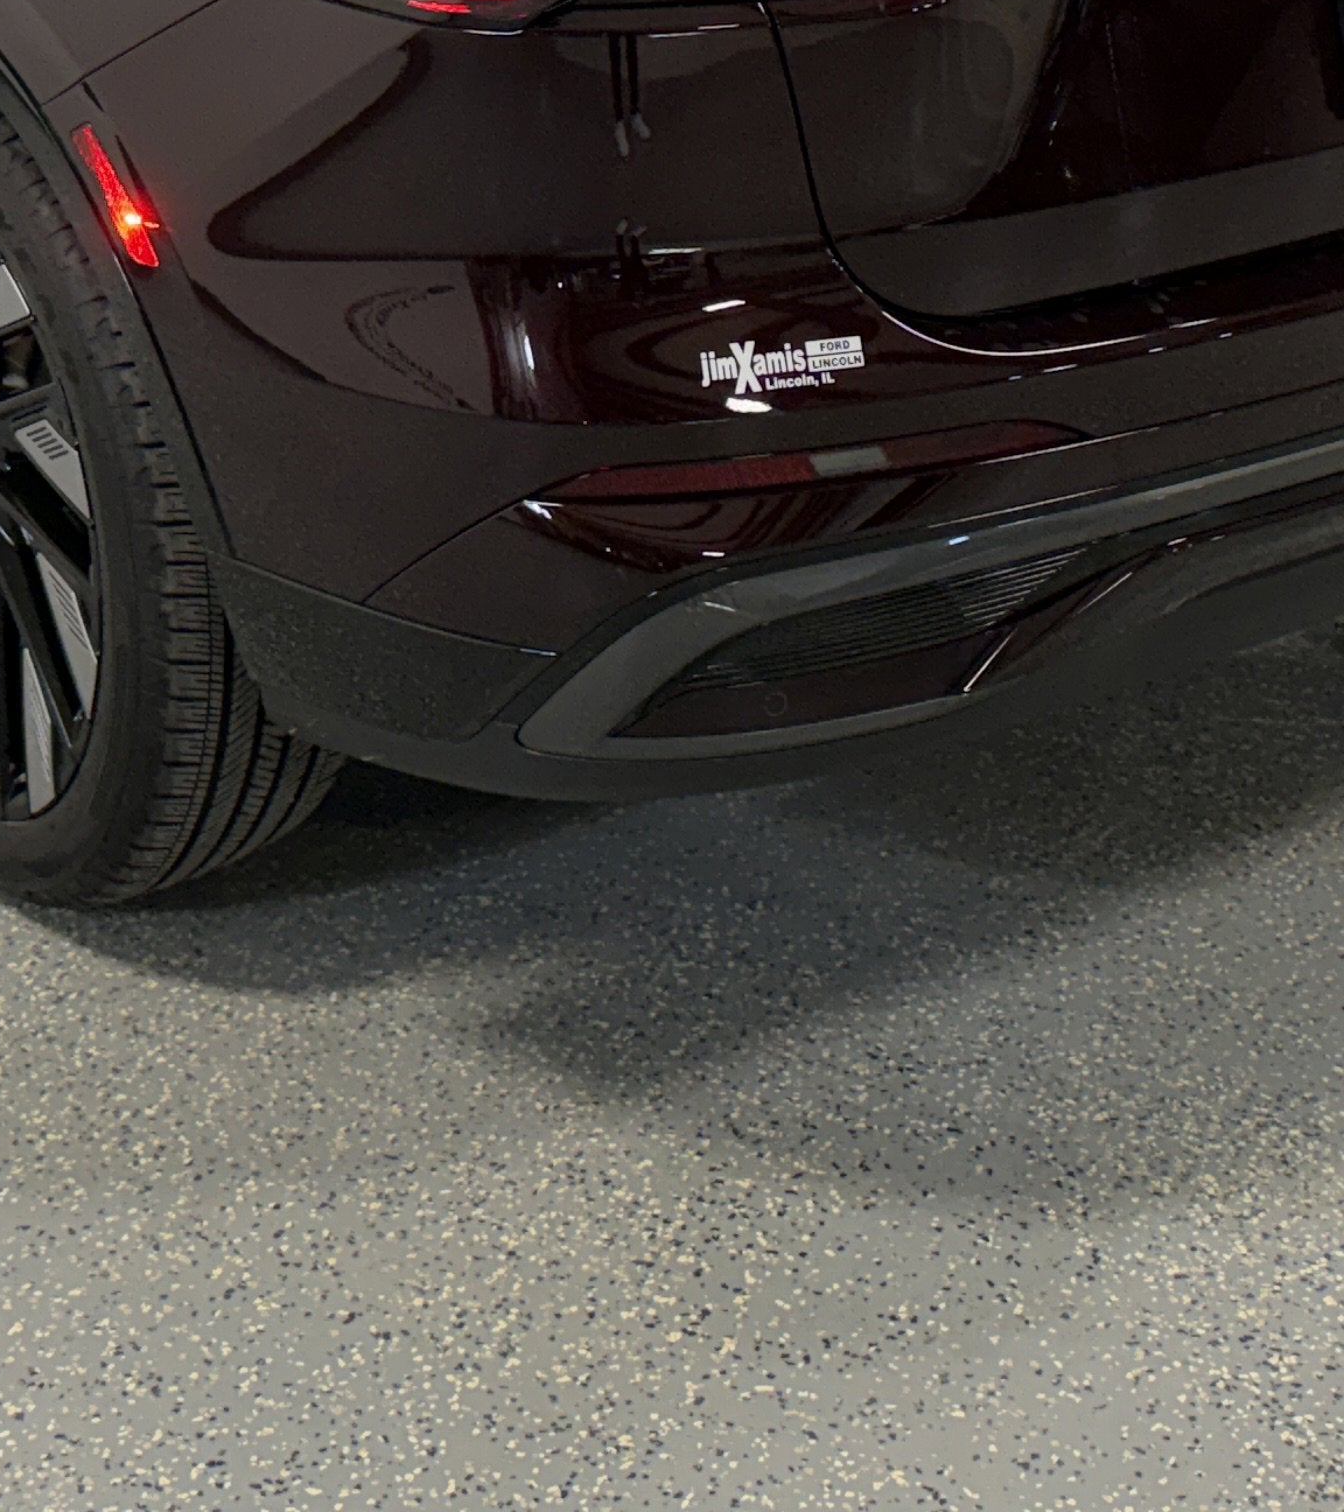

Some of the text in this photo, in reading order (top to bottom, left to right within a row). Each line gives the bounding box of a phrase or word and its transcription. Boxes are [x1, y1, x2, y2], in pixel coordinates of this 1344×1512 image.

[819, 339, 850, 352] FORD
[811, 355, 863, 369] LINCOLN
[821, 372, 836, 385] IL
